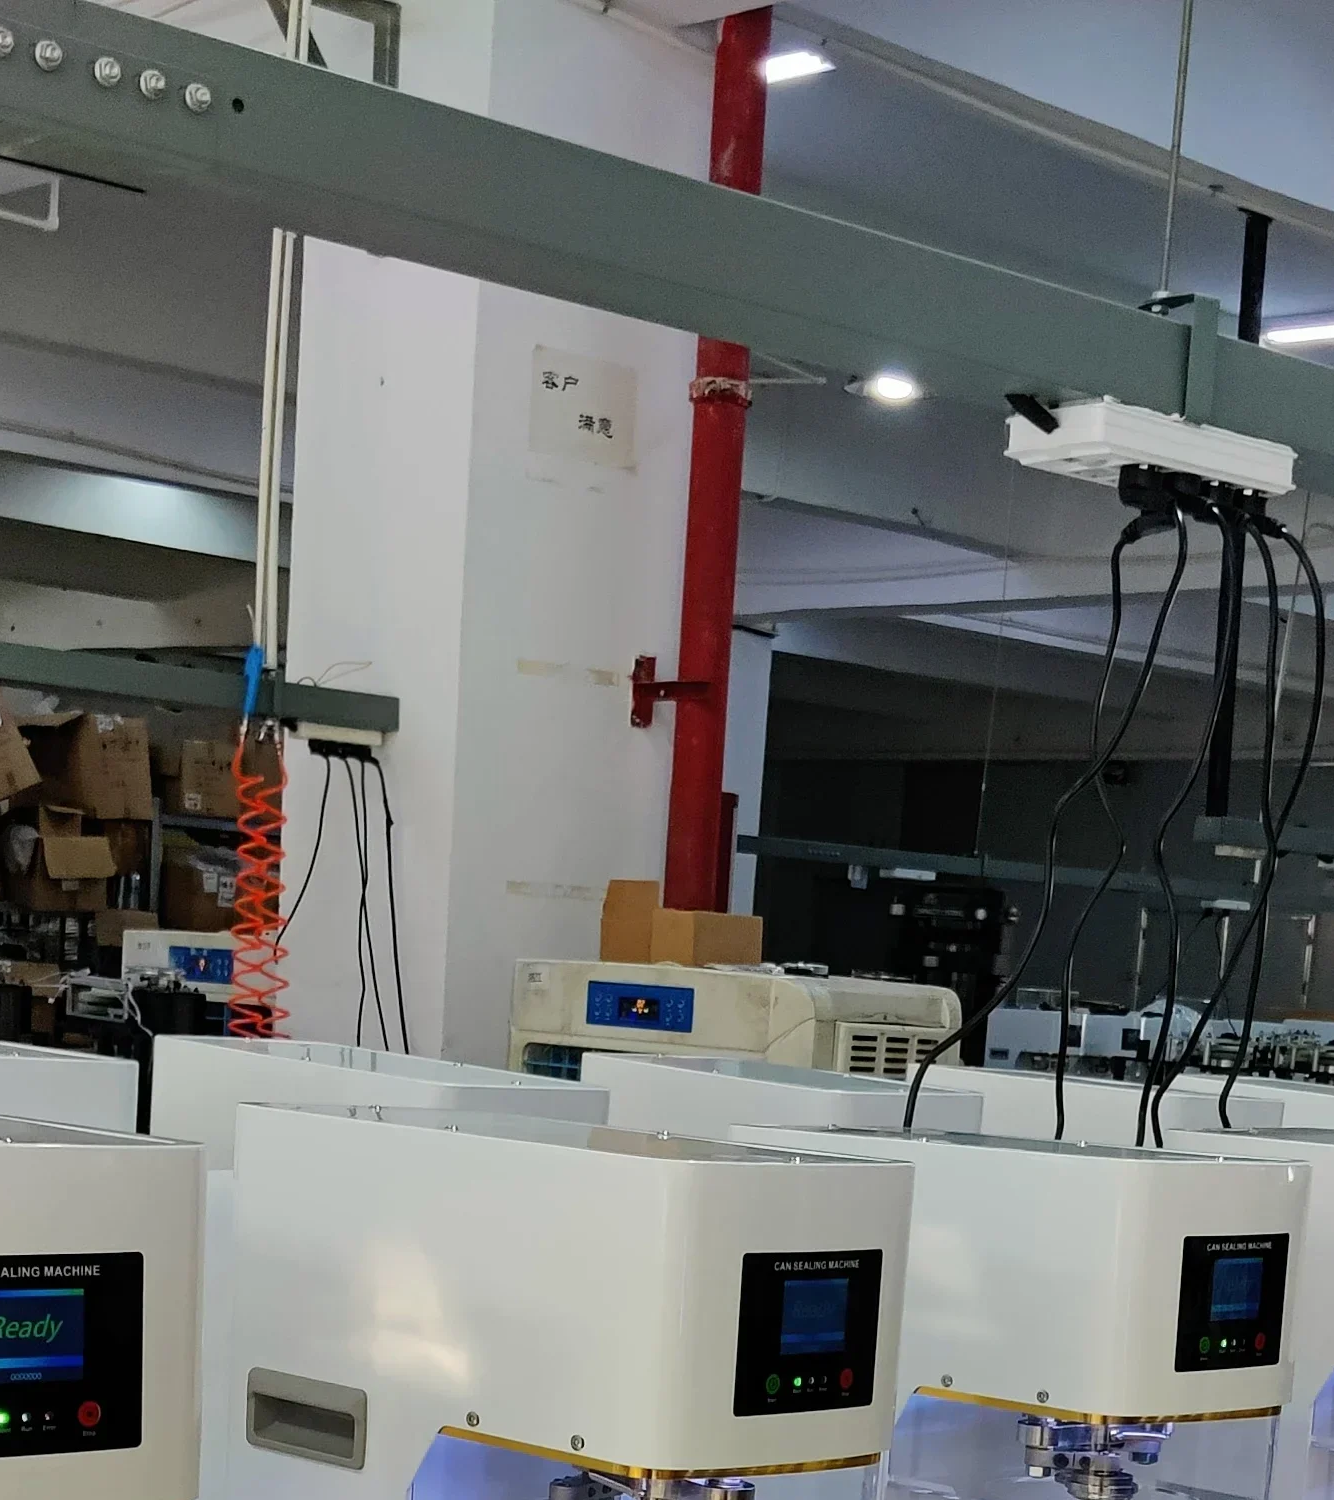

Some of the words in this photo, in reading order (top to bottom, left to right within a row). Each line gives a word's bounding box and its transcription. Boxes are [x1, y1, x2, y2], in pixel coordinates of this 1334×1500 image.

[542, 371, 579, 391] 客户
[44, 1265, 101, 1277] MACHINE
[774, 1261, 792, 1271] CAN
[793, 1261, 827, 1272] SEALING
